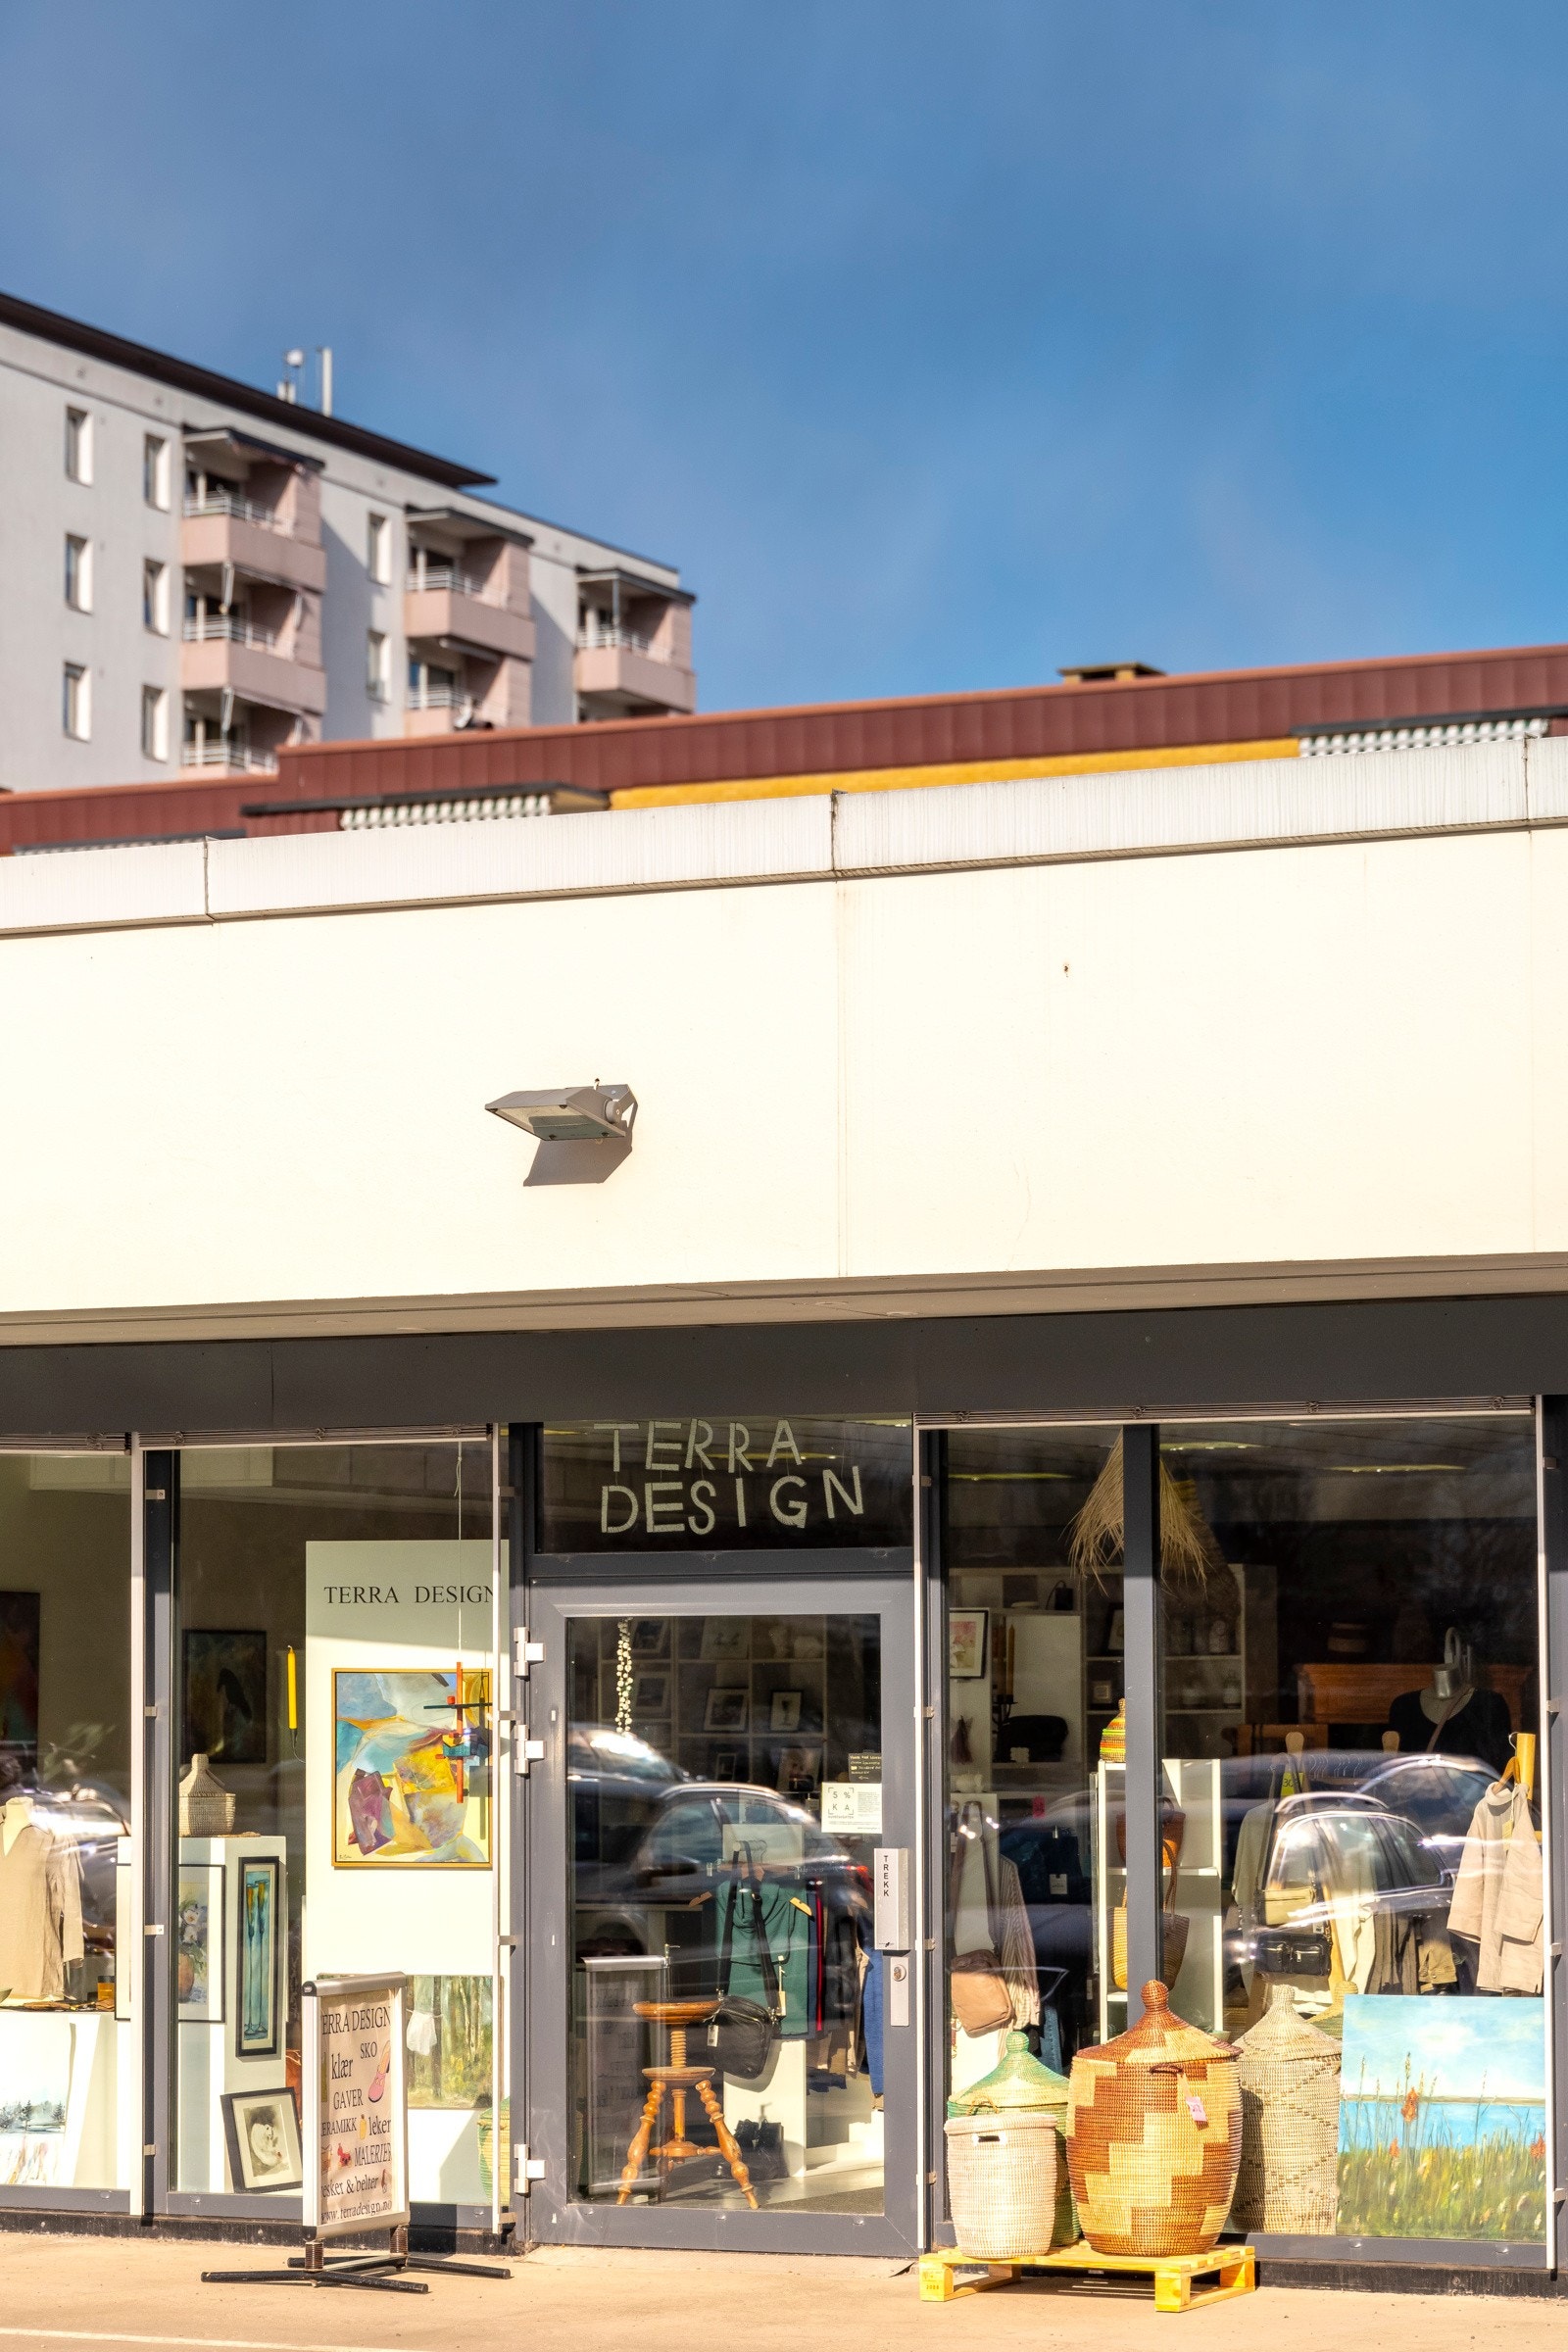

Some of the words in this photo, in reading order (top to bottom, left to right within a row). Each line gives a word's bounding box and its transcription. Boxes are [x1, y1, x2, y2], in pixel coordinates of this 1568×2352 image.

[594, 1419, 804, 1474] TERRA
[600, 1465, 864, 1536] DESIGN
[323, 1586, 400, 1604] TERRA
[321, 2012, 350, 2035] ERRA
[360, 2041, 378, 2060] SKO
[331, 2052, 354, 2080] klær
[333, 2088, 364, 2110] GAVER
[321, 2117, 358, 2137] ERAMIKK
[368, 2115, 392, 2136] leker
[321, 2179, 345, 2198] esker
[346, 2179, 355, 2194] &
[355, 2174, 379, 2192] belter
